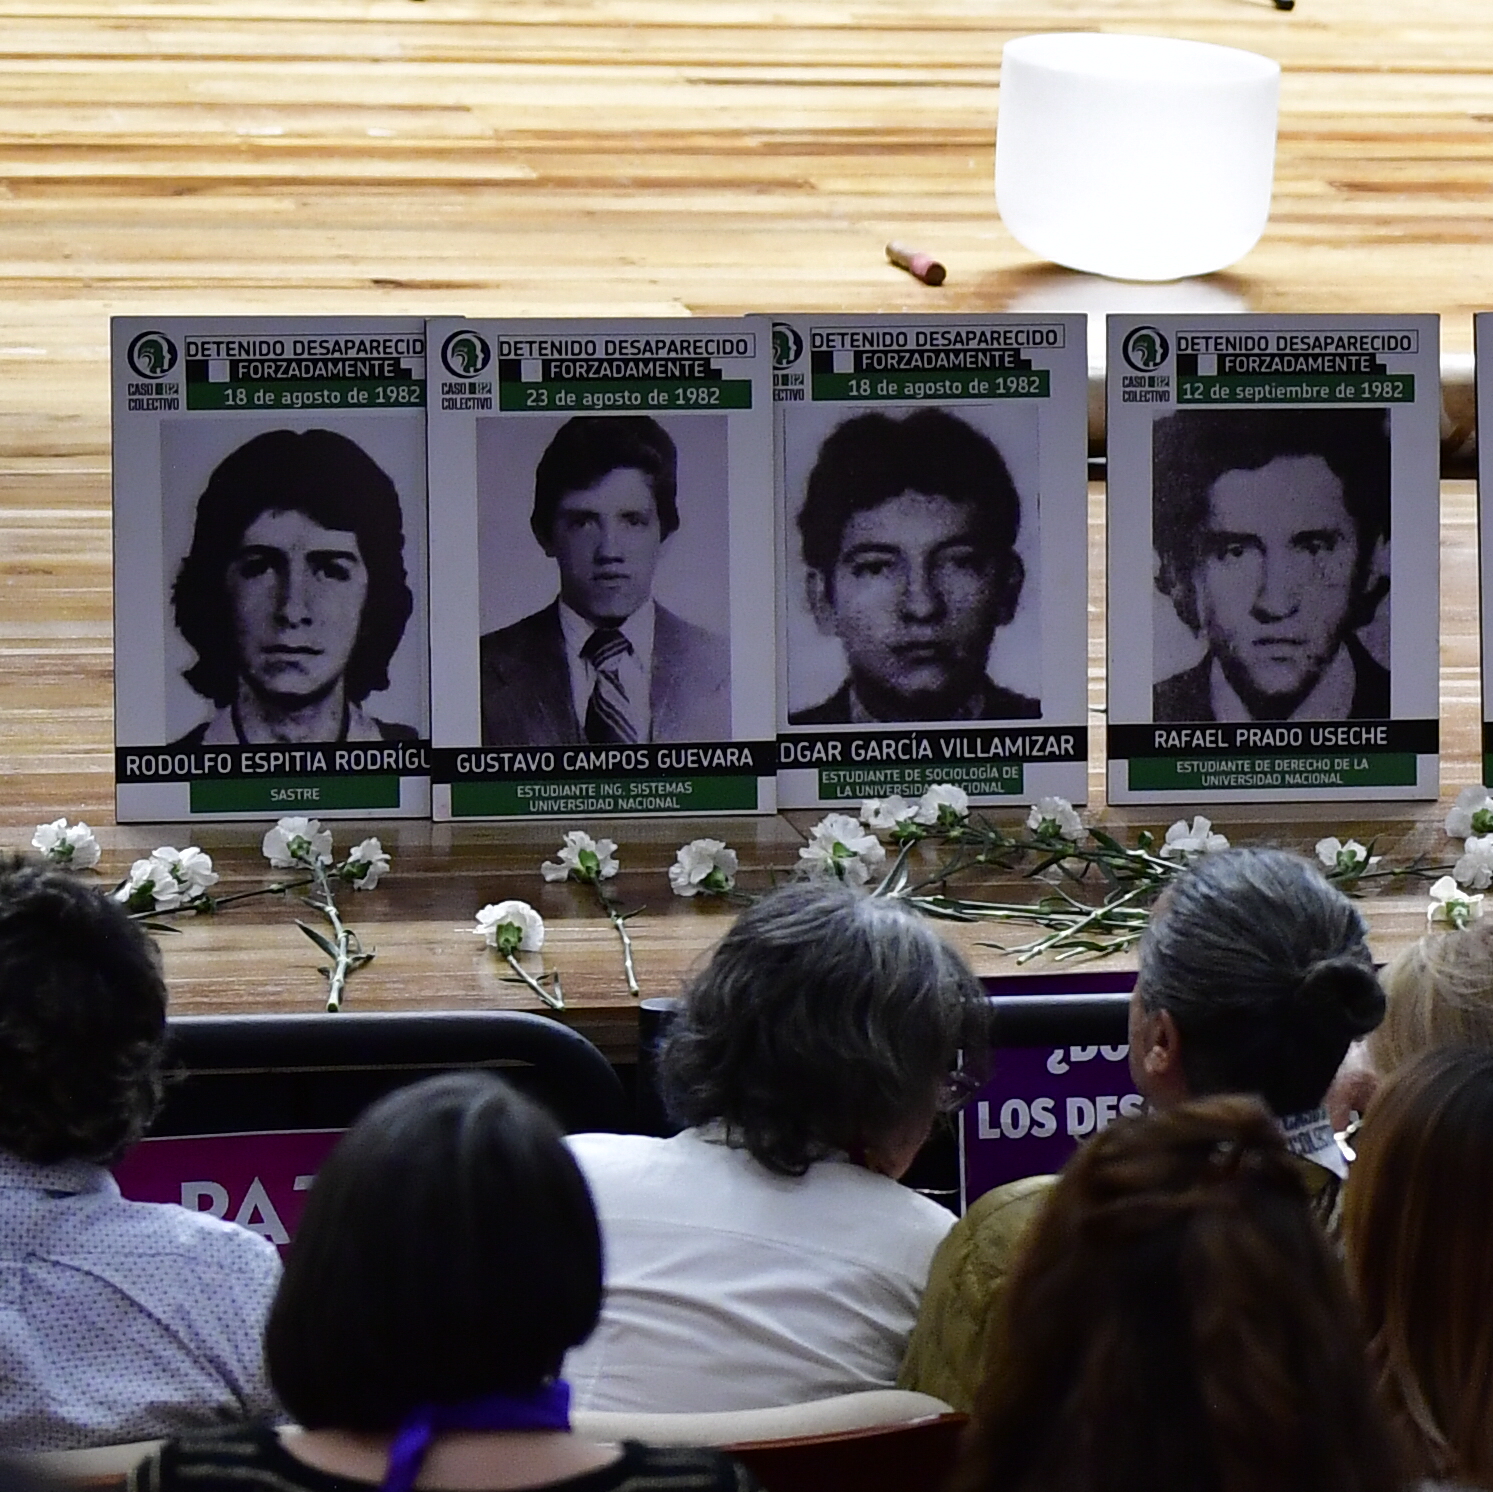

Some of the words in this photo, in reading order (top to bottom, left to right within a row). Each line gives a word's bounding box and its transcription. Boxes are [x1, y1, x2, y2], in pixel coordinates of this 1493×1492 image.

[500, 340, 597, 356] DETENIDO
[605, 339, 748, 356] DESAPARECIDO
[813, 332, 908, 348] DETENIDO
[916, 330, 1057, 347] DESAPARECIDO
[1178, 336, 1268, 352] DETENIDO
[1276, 335, 1411, 351] DESAPARECIDO
[187, 341, 285, 357] DETENIDO
[293, 339, 424, 356] DESAPARECID
[863, 352, 1014, 369] FORZADAMENTE
[1226, 357, 1370, 372] FORZADAMENTE
[239, 361, 395, 378] FORZADAMENTE
[551, 361, 705, 378] FORZADAMENTE
[1123, 376, 1145, 388] CASO
[527, 391, 548, 406] 23
[556, 390, 575, 405] de
[583, 389, 640, 407] agosto
[649, 389, 668, 404] de
[676, 389, 719, 404] 1982
[1123, 390, 1170, 402] COLECTIVO
[1183, 383, 1203, 398] 12
[1210, 383, 1229, 398] de
[1236, 383, 1329, 401] septiembre
[1336, 383, 1354, 398] de
[1361, 383, 1403, 397] 1982
[1155, 729, 1228, 748] RAFAEL
[1237, 728, 1302, 746] PRADO
[1310, 727, 1388, 745] USECHE
[775, 741, 841, 763] DGAR
[851, 733, 933, 760] GARCÍA
[941, 736, 1074, 758] VILLAMIZAR
[127, 754, 232, 776] RODOLFO
[241, 752, 327, 772] ESPITIA
[336, 743, 430, 770] RODRÍGU
[457, 753, 554, 773] GUSTAVO
[563, 750, 649, 770] CAMPOS
[658, 748, 753, 768] GUEVARA
[1177, 761, 1251, 773] ESTUDIANTE
[1256, 760, 1270, 771] DE
[1275, 759, 1330, 771] DERECHO
[1335, 759, 1350, 770] DE
[1354, 758, 1368, 769] LA
[822, 770, 899, 783] ESTUDIANTE
[905, 770, 921, 781] DE
[926, 764, 998, 780] SOCIOLOGÍA
[1003, 767, 1018, 778] DE
[1202, 775, 1282, 786] UNIVERSIDAD
[1286, 774, 1343, 784] NACIONAL
[271, 789, 320, 801] SASTRE
[518, 785, 595, 797] ESTUDIANTE
[601, 785, 625, 795] ING.
[630, 782, 692, 794] SISTEMAS
[530, 798, 613, 811] UNIVERSIDAD
[619, 797, 680, 809] NACIONAL
[978, 1098, 1057, 1139] LOS
[1066, 1094, 1144, 1136] DES
[181, 1175, 320, 1245] PA
